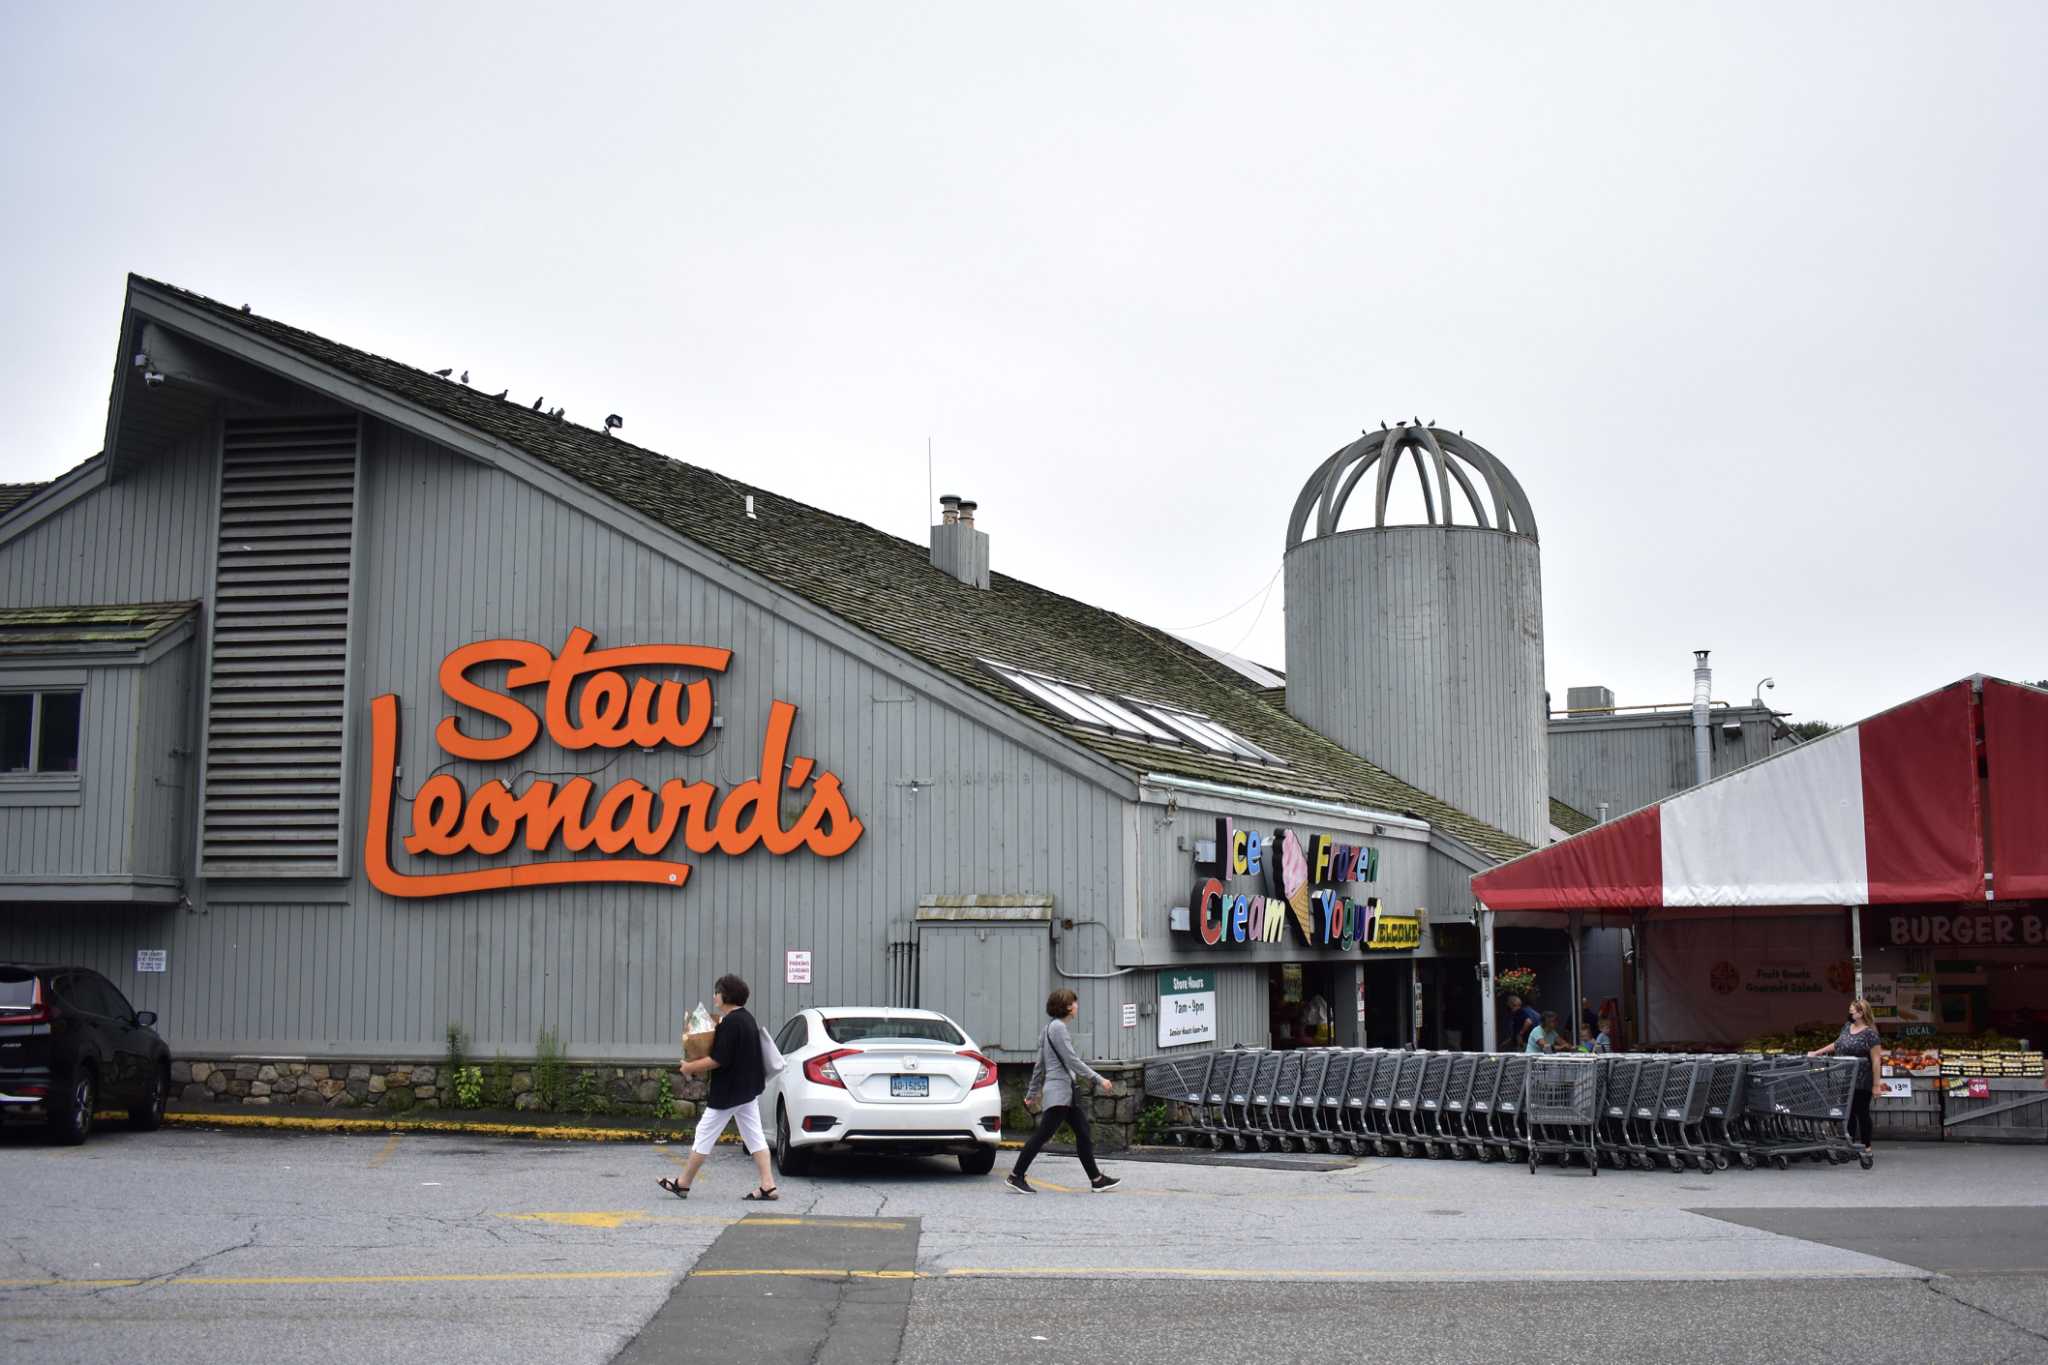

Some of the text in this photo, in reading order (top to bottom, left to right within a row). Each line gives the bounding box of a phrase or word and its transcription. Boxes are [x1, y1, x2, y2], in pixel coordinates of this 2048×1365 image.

[435, 626, 733, 760] Stew
[365, 693, 865, 897] Leonard's
[1222, 816, 1262, 880] Ice
[1312, 834, 1379, 884] Frozen
[1197, 878, 1286, 945] Cream
[1315, 888, 1383, 951] Yogurt
[1889, 914, 2048, 944] BURGER B
[1173, 976, 1204, 990] Store Hours
[1906, 1026, 1930, 1035] LOCAL
